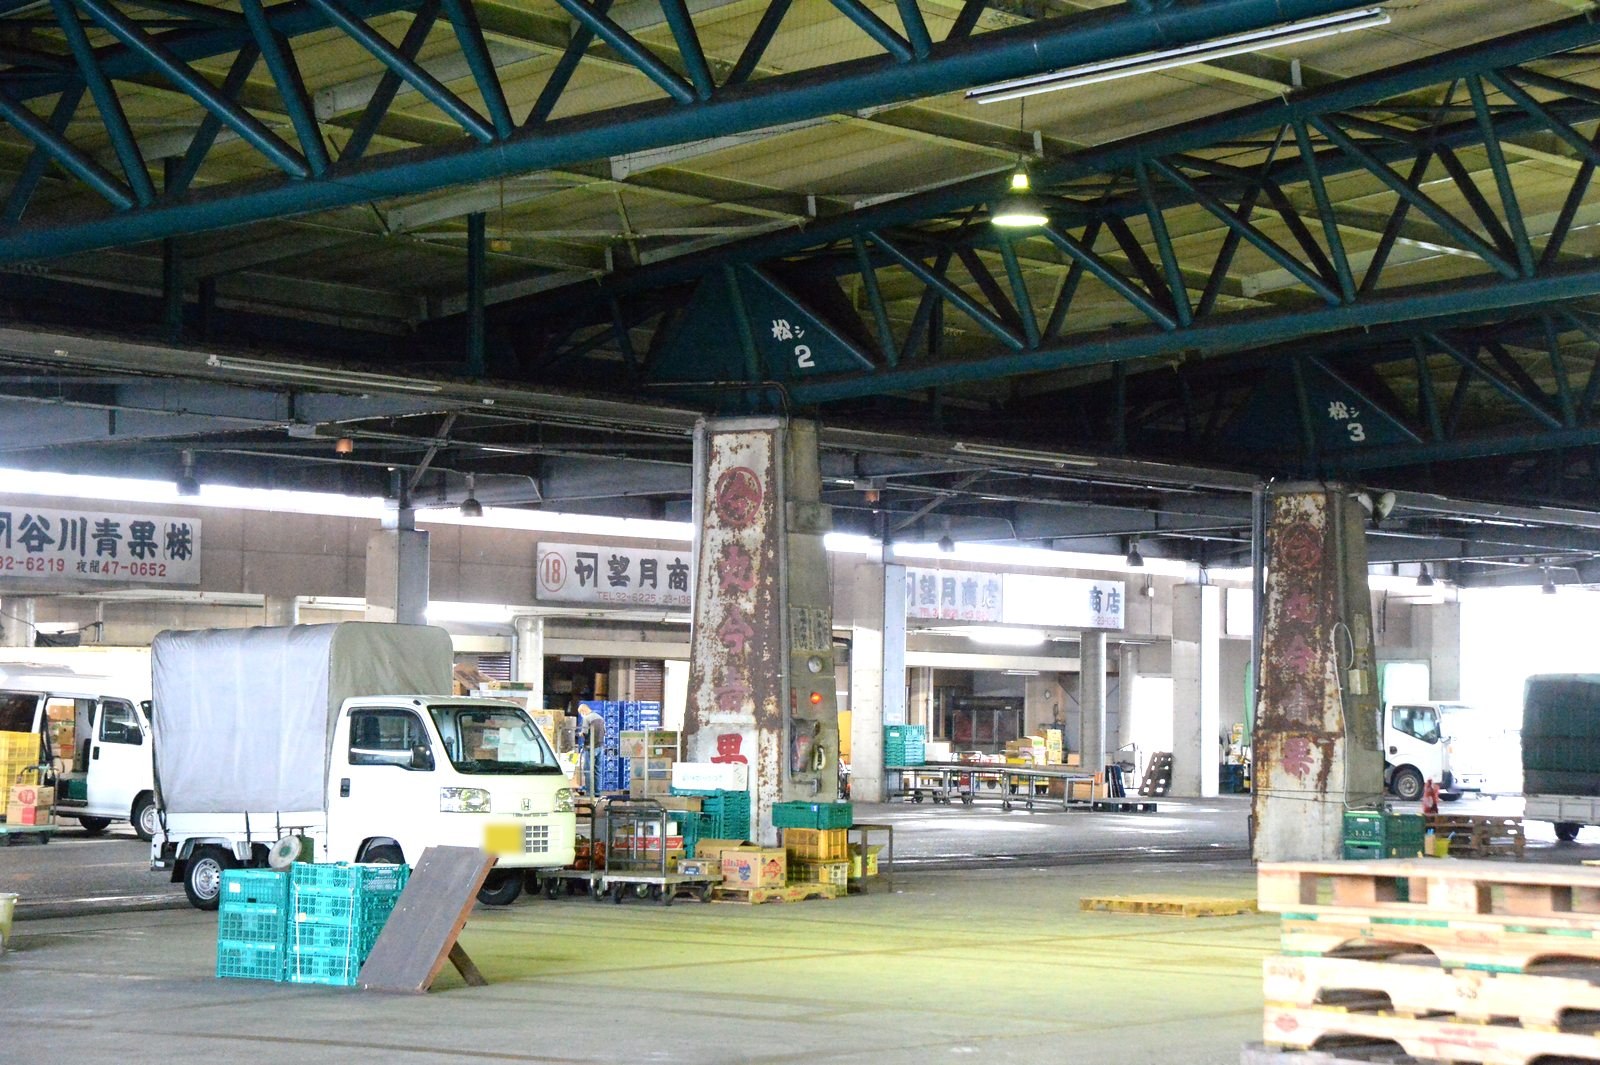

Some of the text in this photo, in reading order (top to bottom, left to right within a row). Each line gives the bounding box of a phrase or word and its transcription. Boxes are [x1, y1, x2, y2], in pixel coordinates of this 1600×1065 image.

[794, 344, 815, 368] 2
[1347, 422, 1365, 441] 3
[545, 558, 561, 584] 18
[1088, 585, 1121, 615] 商店
